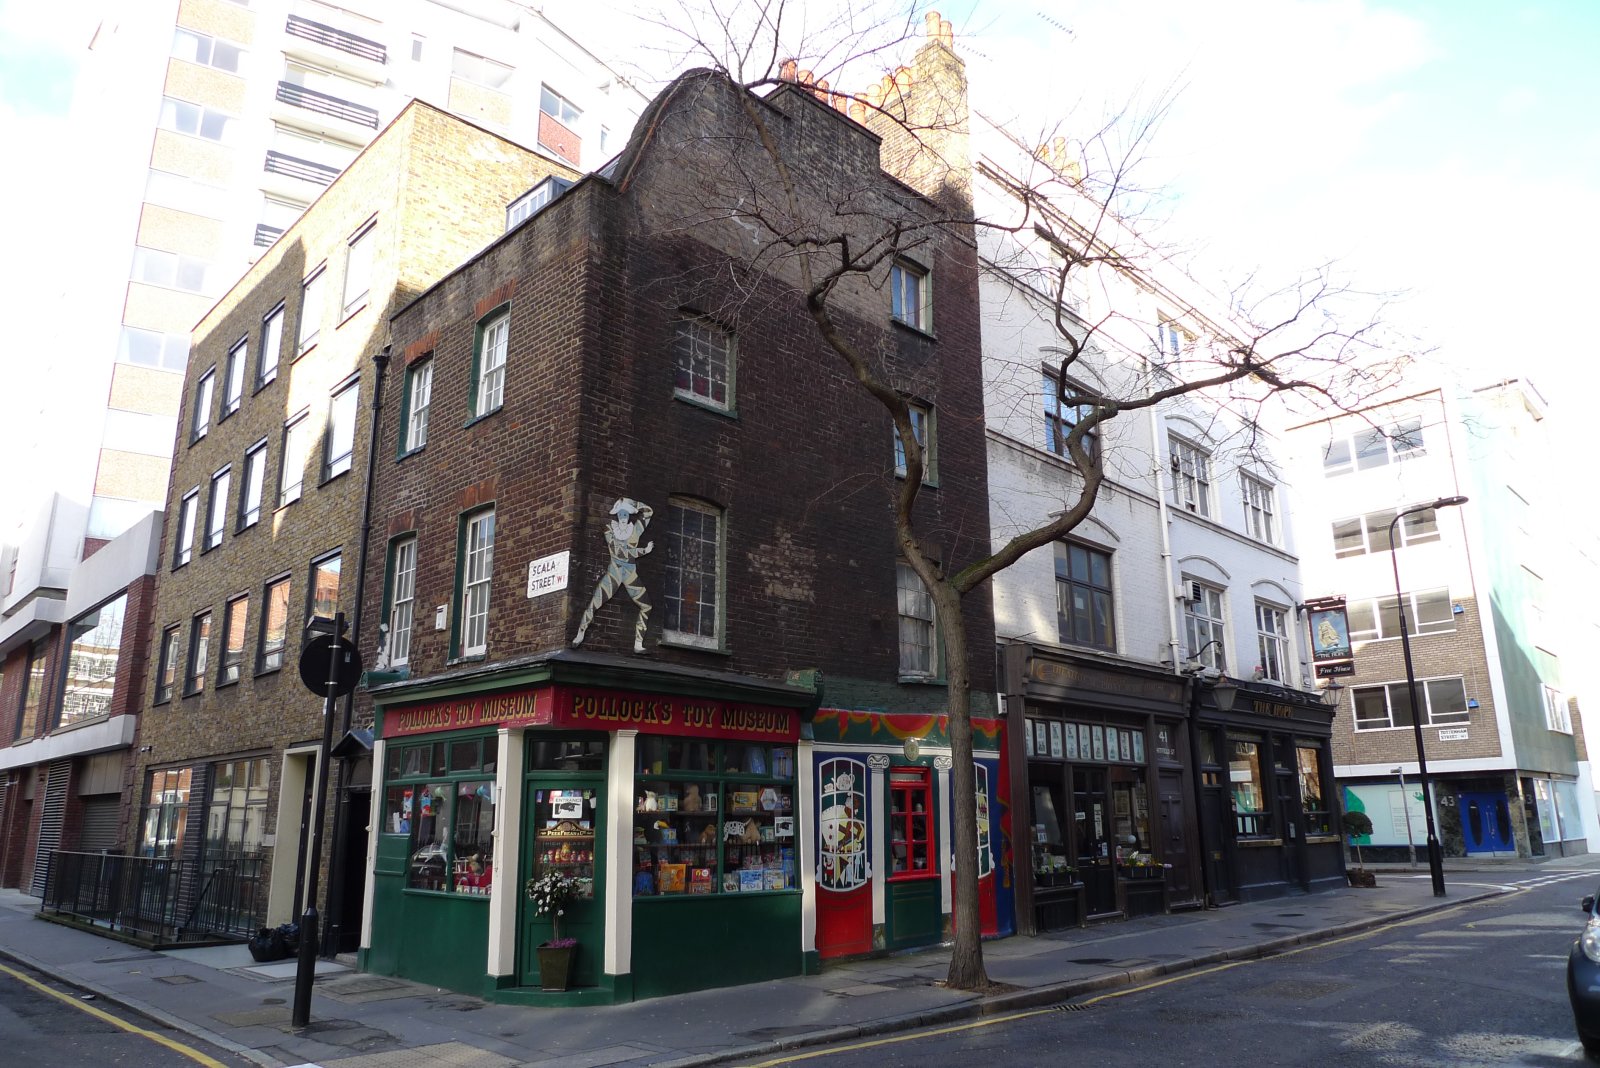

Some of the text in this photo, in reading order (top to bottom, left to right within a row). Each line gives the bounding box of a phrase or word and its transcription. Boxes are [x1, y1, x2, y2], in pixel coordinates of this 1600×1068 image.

[532, 560, 556, 577] SCALA
[531, 575, 566, 591] STREET W1
[1319, 667, 1332, 675] Free
[398, 693, 538, 731] POLLOCK'S TOY MUSEUM
[1253, 700, 1271, 713] THE
[571, 696, 790, 735] POLLOCK'S TOY MUSEUM
[1440, 795, 1456, 807] 43
